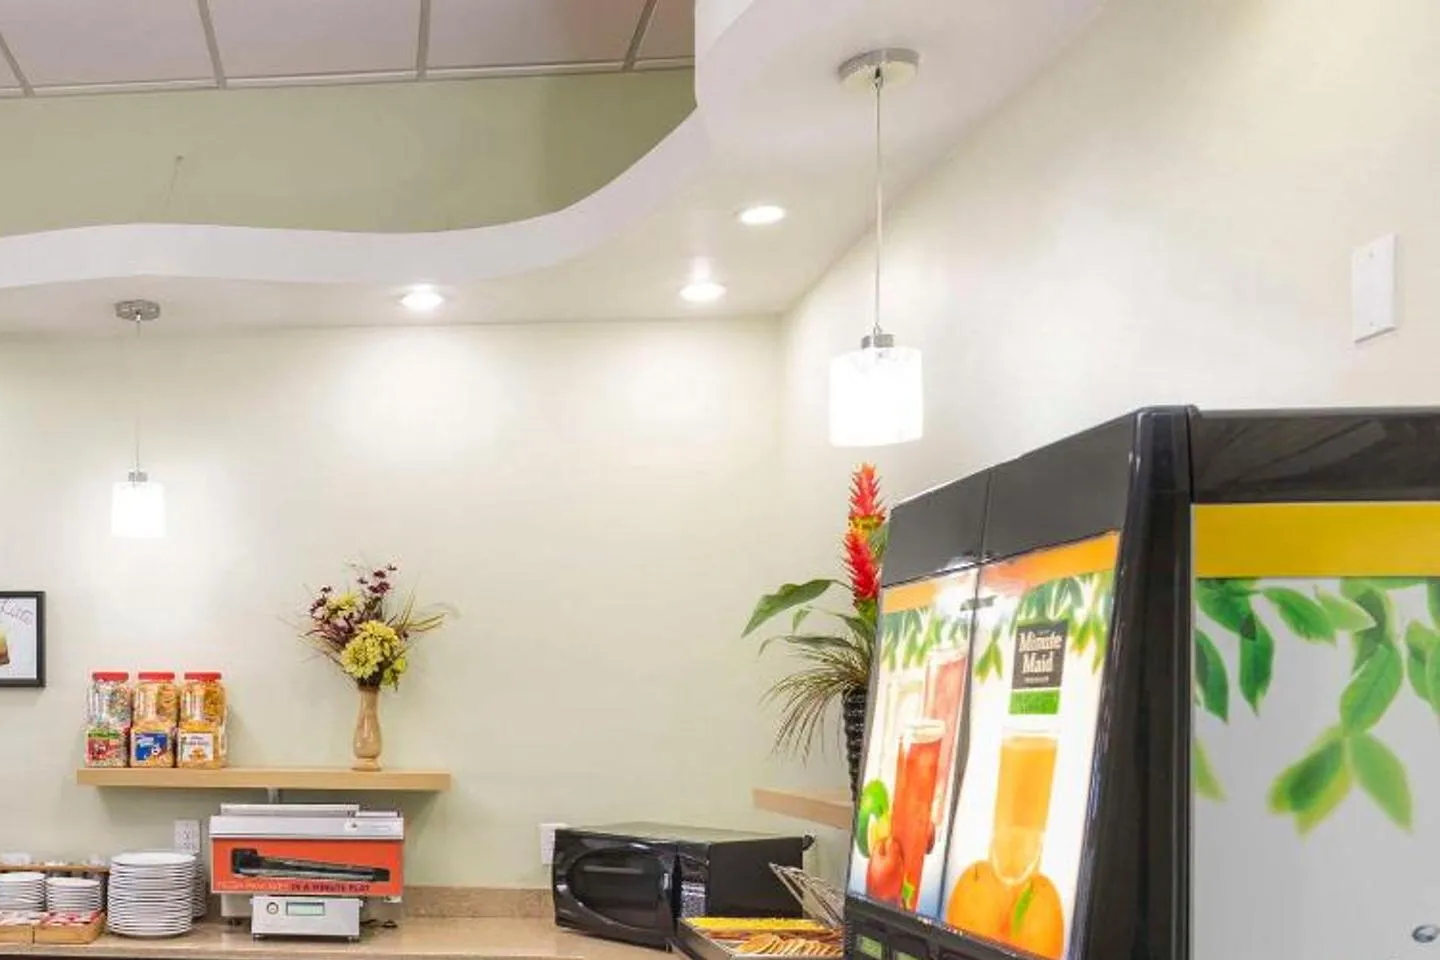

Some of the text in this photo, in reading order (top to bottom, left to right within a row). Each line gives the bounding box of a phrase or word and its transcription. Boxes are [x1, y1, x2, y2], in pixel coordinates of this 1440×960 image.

[1019, 631, 1062, 651] Minute
[1022, 651, 1054, 674] Maid
[303, 883, 310, 891] A
